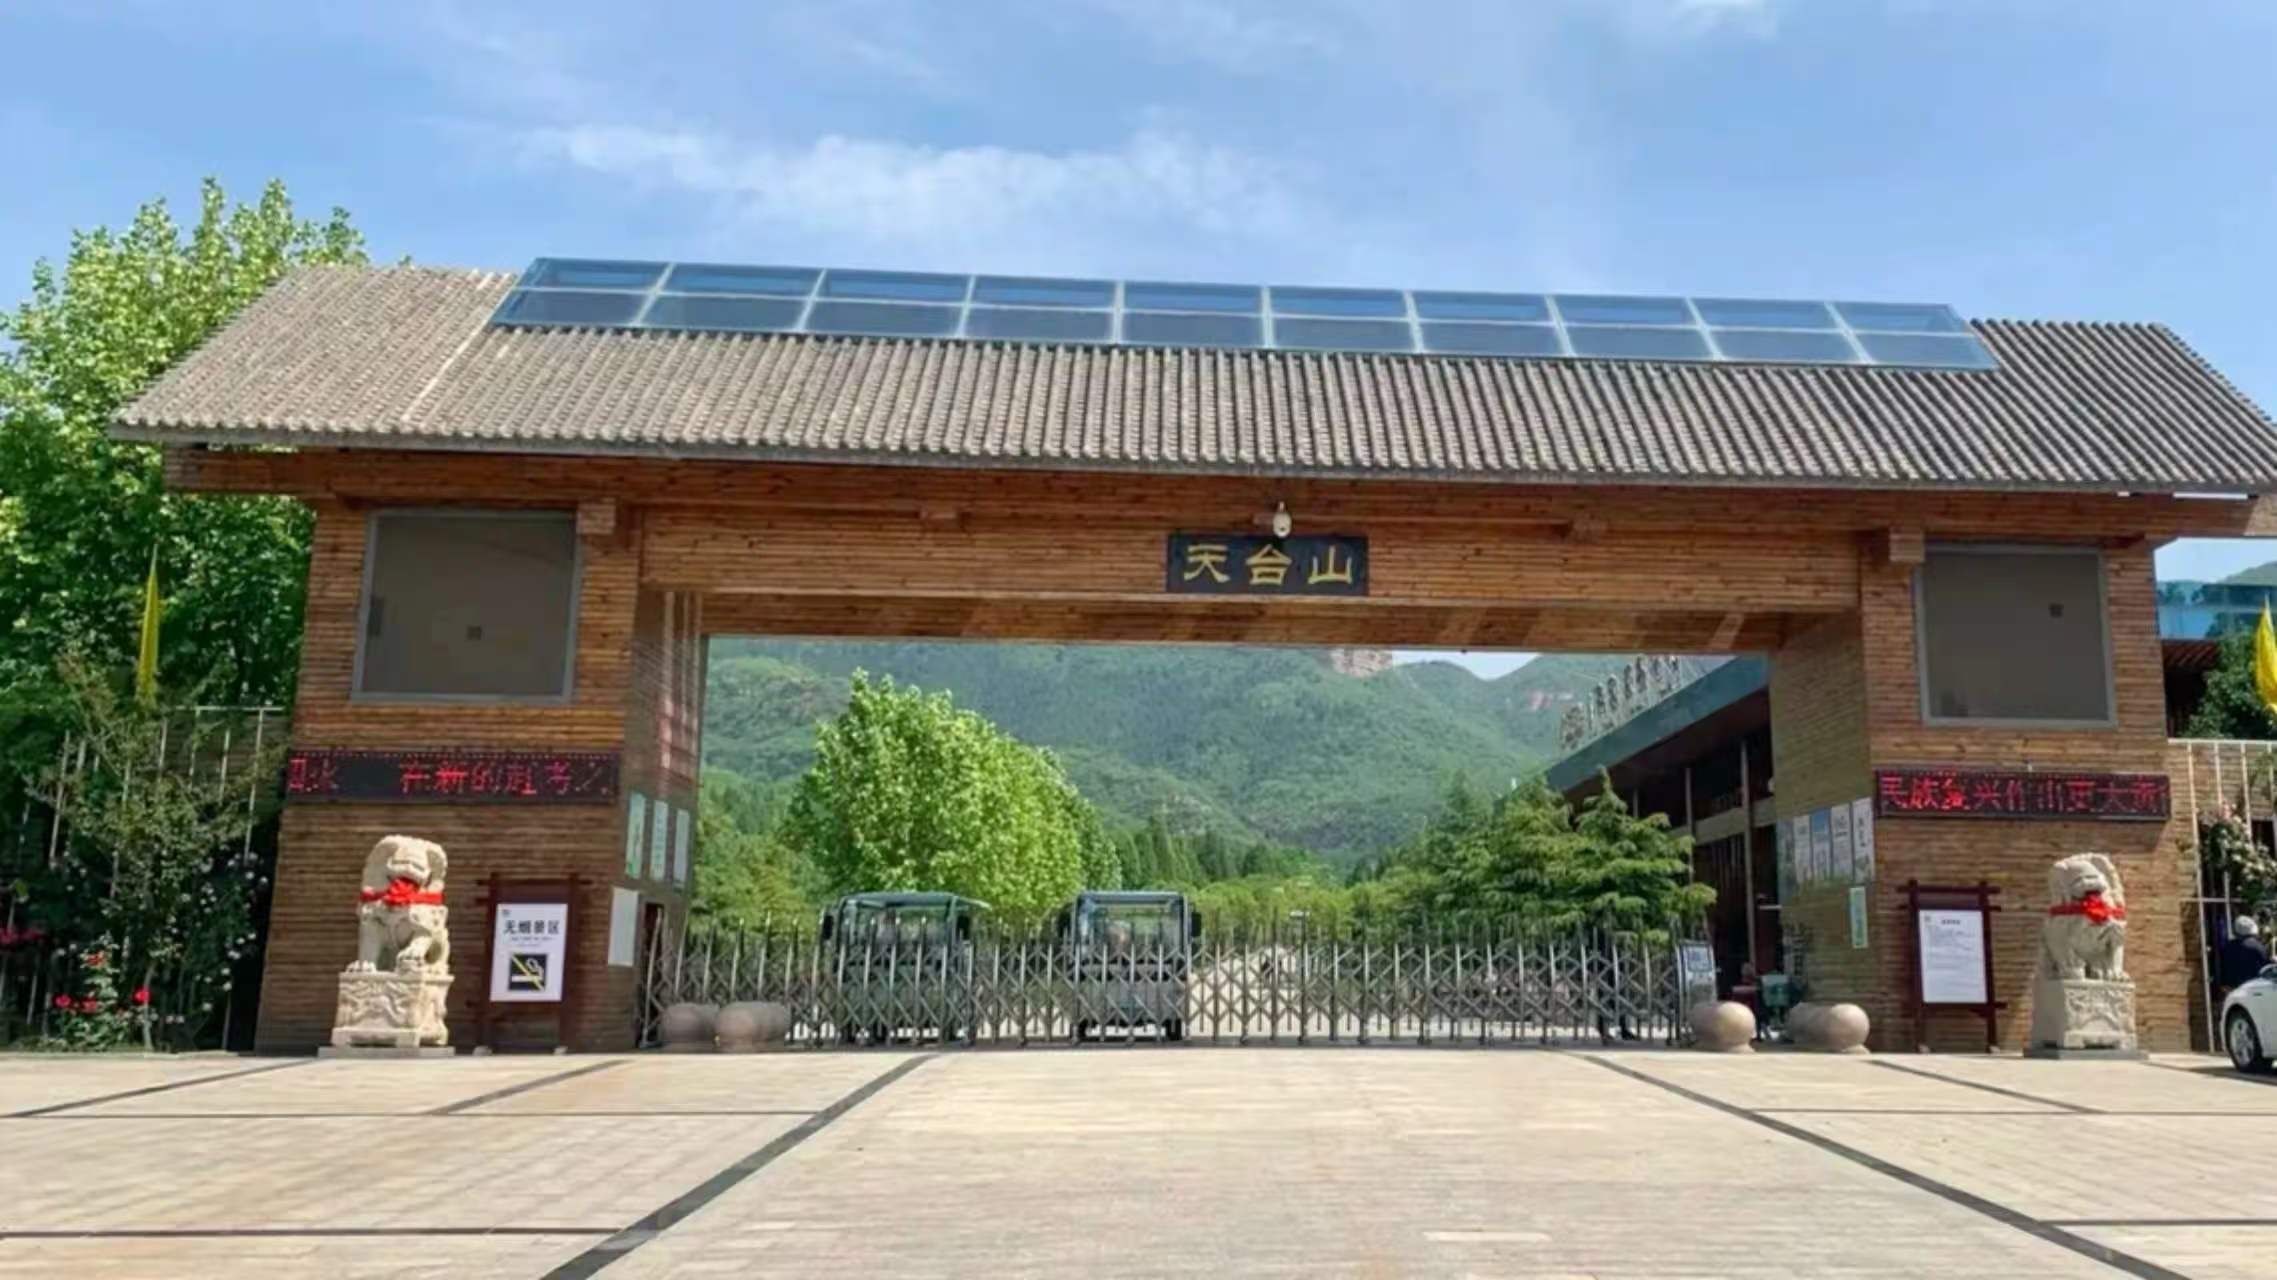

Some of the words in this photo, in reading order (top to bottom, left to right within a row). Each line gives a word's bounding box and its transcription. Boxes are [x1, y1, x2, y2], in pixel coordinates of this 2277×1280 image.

[1183, 543, 1353, 586] 天台山
[502, 920, 560, 935] 无烟景区
